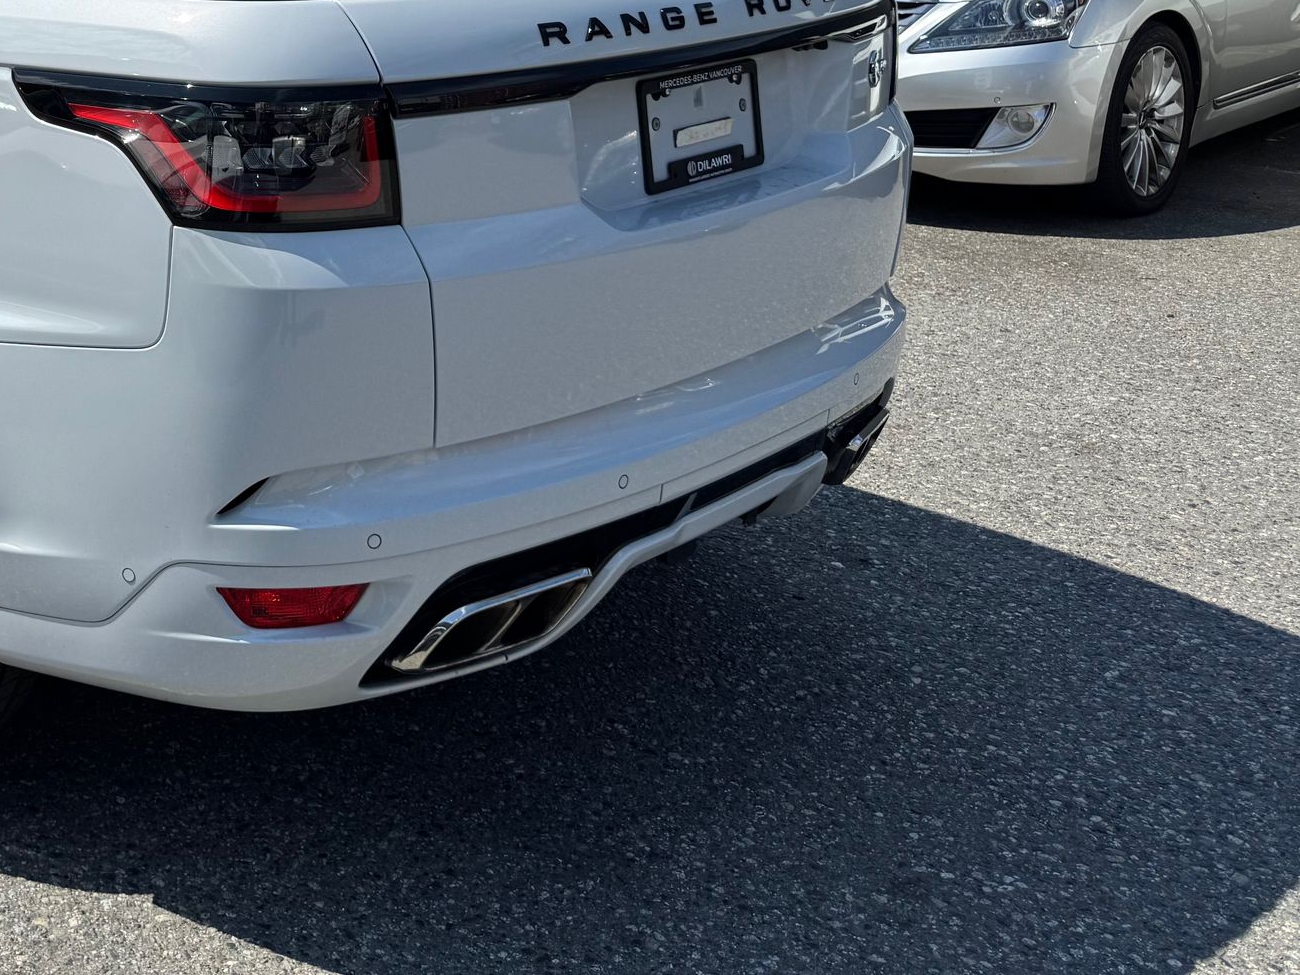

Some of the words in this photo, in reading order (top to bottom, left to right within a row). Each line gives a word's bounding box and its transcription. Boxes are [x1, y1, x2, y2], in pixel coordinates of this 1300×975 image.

[537, 1, 718, 47] RANGE
[659, 71, 709, 89] MERCEDES-BENZ
[709, 65, 742, 80] VANCOUVER
[697, 153, 732, 172] DILAWRI
